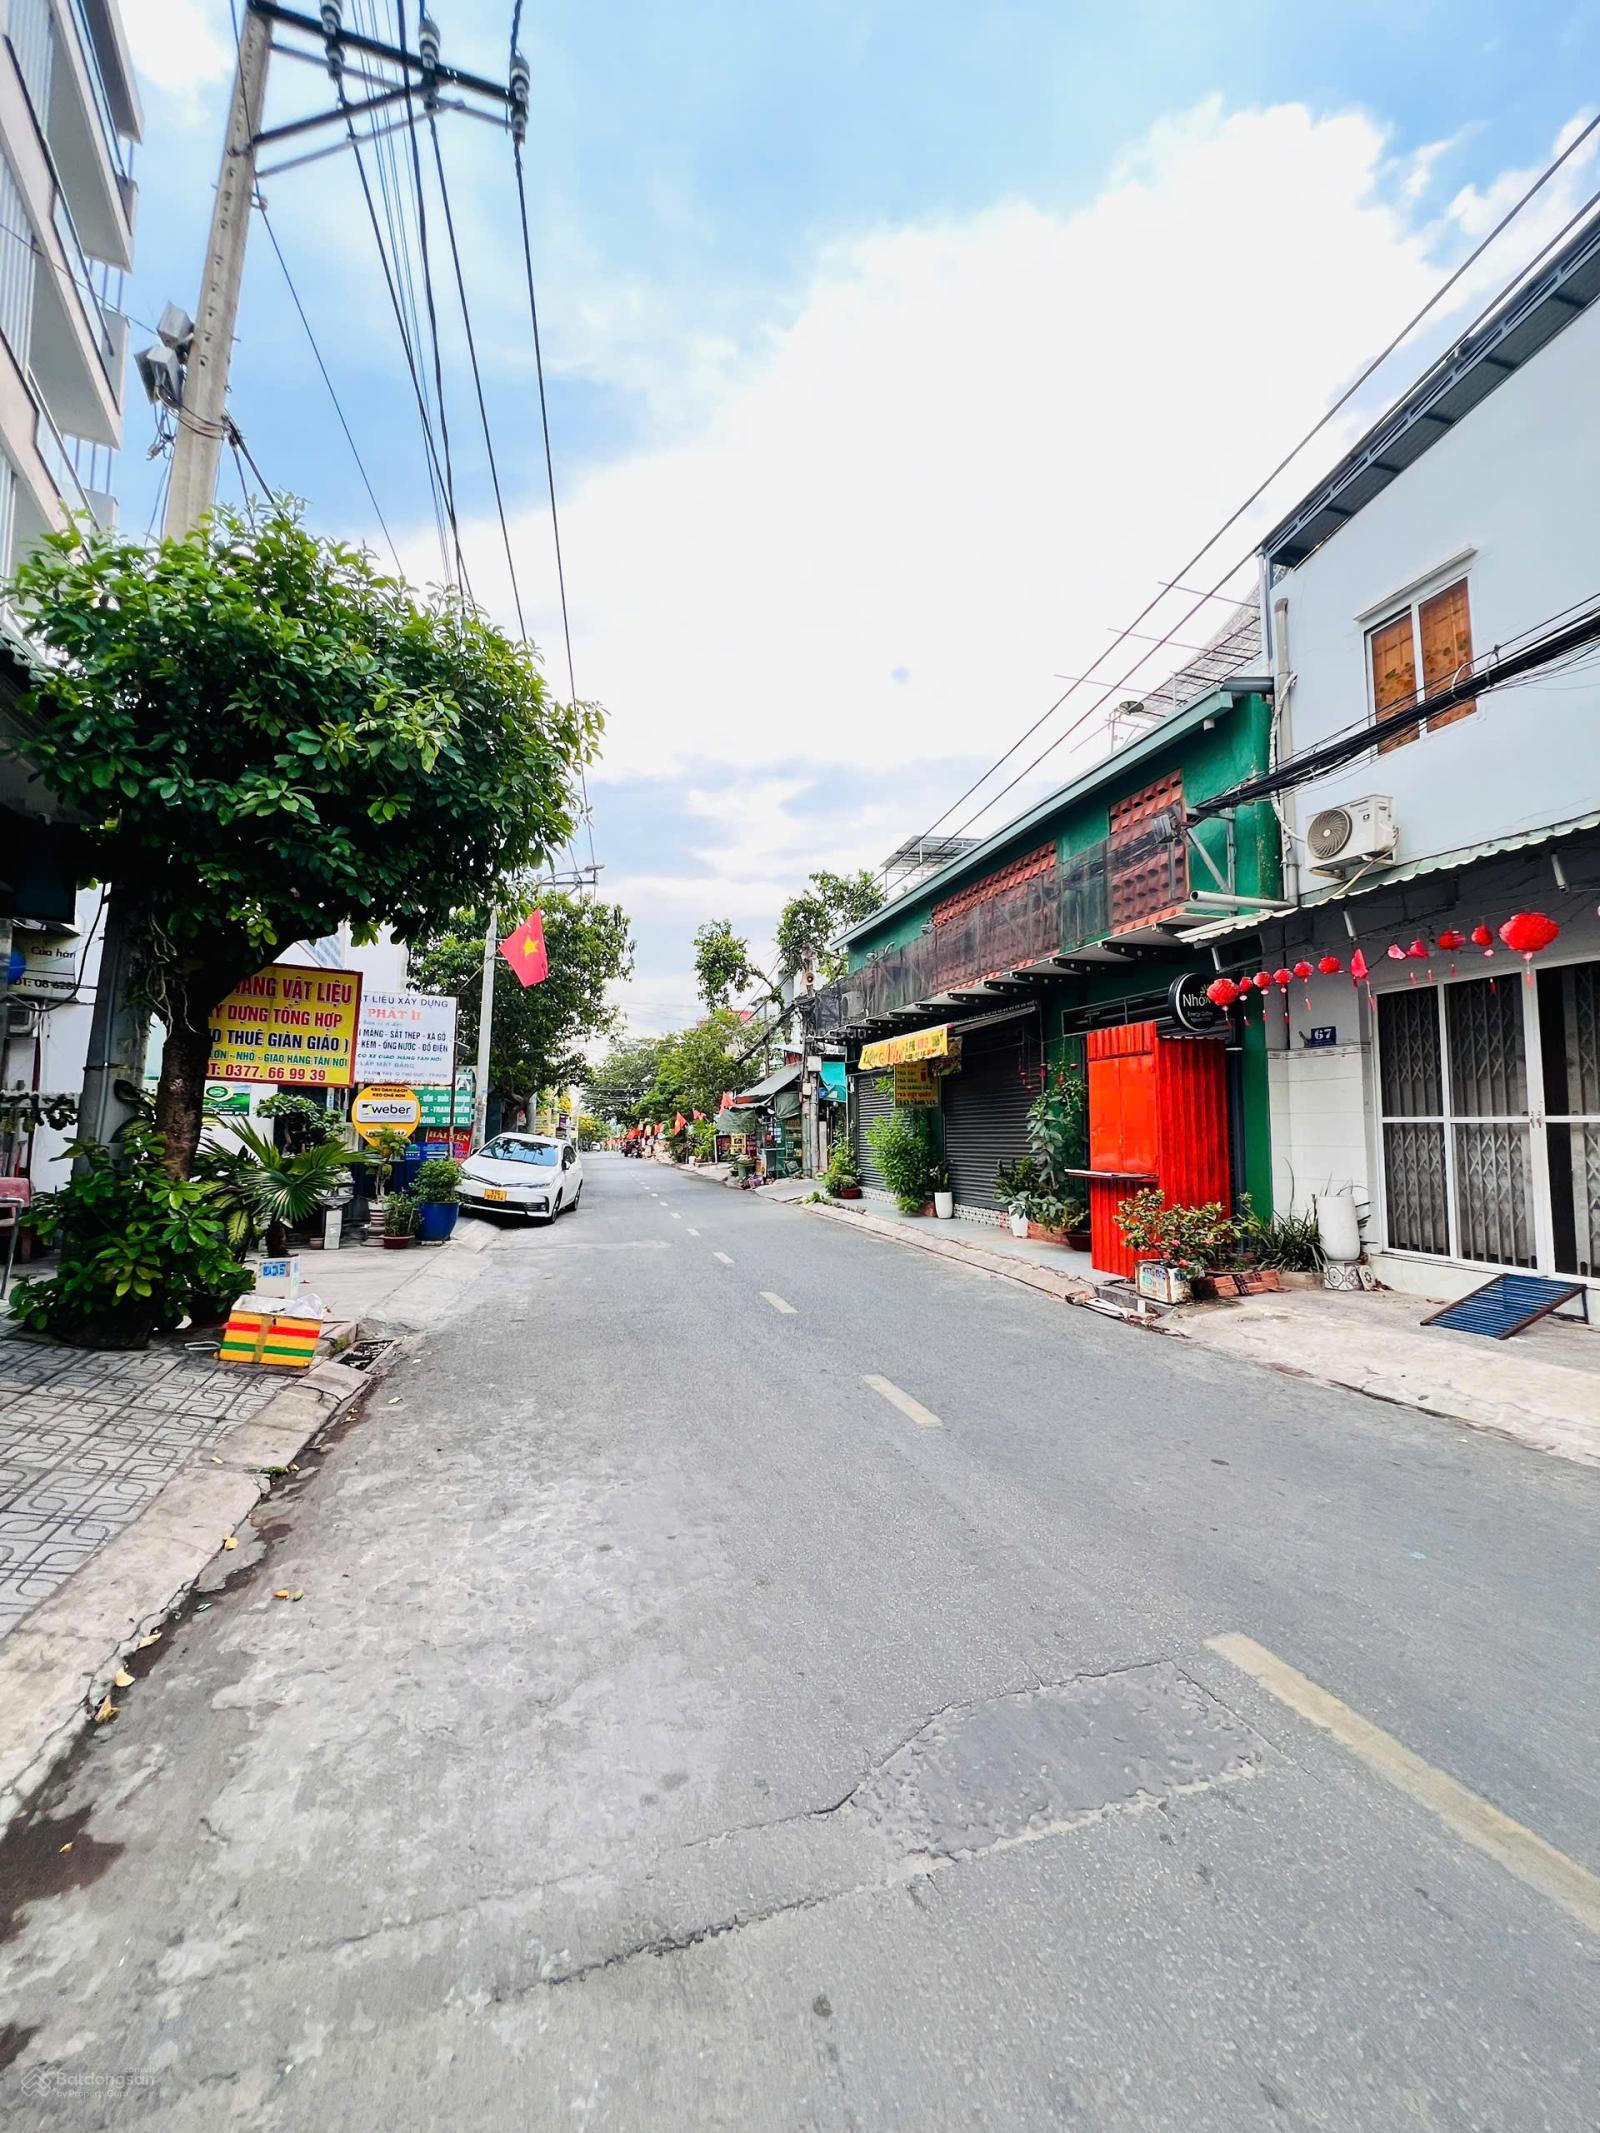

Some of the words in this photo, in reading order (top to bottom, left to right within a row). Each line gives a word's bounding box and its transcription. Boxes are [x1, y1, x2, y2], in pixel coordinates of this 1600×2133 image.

[282, 976, 312, 1005] VẬT
[317, 979, 352, 1008] LIỆU
[228, 1004, 268, 1024] DỰNG
[274, 1003, 310, 1026] TỔNG
[314, 1012, 343, 1031] HỢP
[228, 1028, 264, 1046] THUÊ
[307, 1033, 339, 1051] GIÁO
[1314, 1029, 1332, 1040] 67
[264, 1053, 284, 1063] GIAO
[208, 1063, 221, 1076] T:
[225, 1063, 263, 1079] 0377.
[268, 1067, 285, 1079] 66
[288, 1068, 306, 1080] 99
[309, 1069, 326, 1081] 39
[371, 1104, 412, 1114] weber
